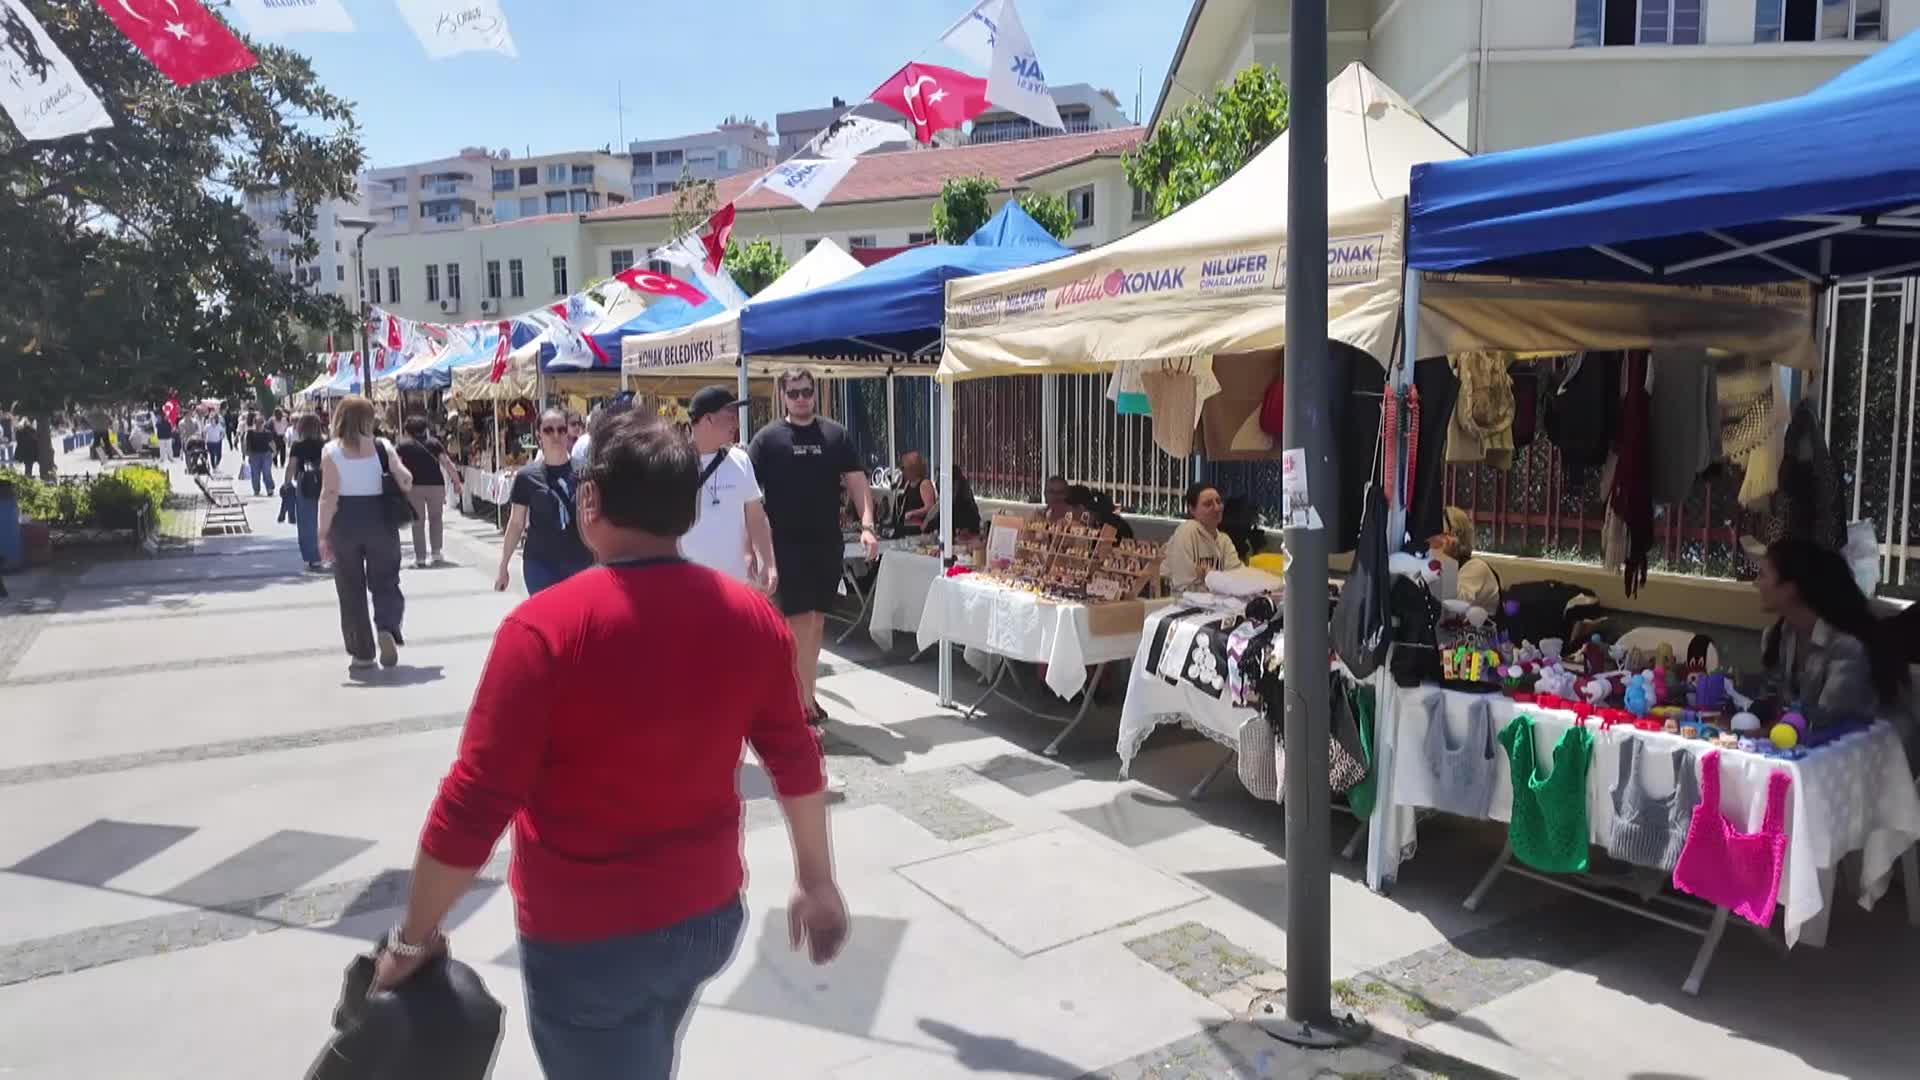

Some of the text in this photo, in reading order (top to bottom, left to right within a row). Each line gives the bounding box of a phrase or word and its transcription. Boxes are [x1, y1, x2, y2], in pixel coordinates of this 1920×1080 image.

[1328, 245, 1374, 264] ONAK
[1120, 266, 1186, 294] KONAK
[664, 334, 714, 366] BELEDİYESİ
